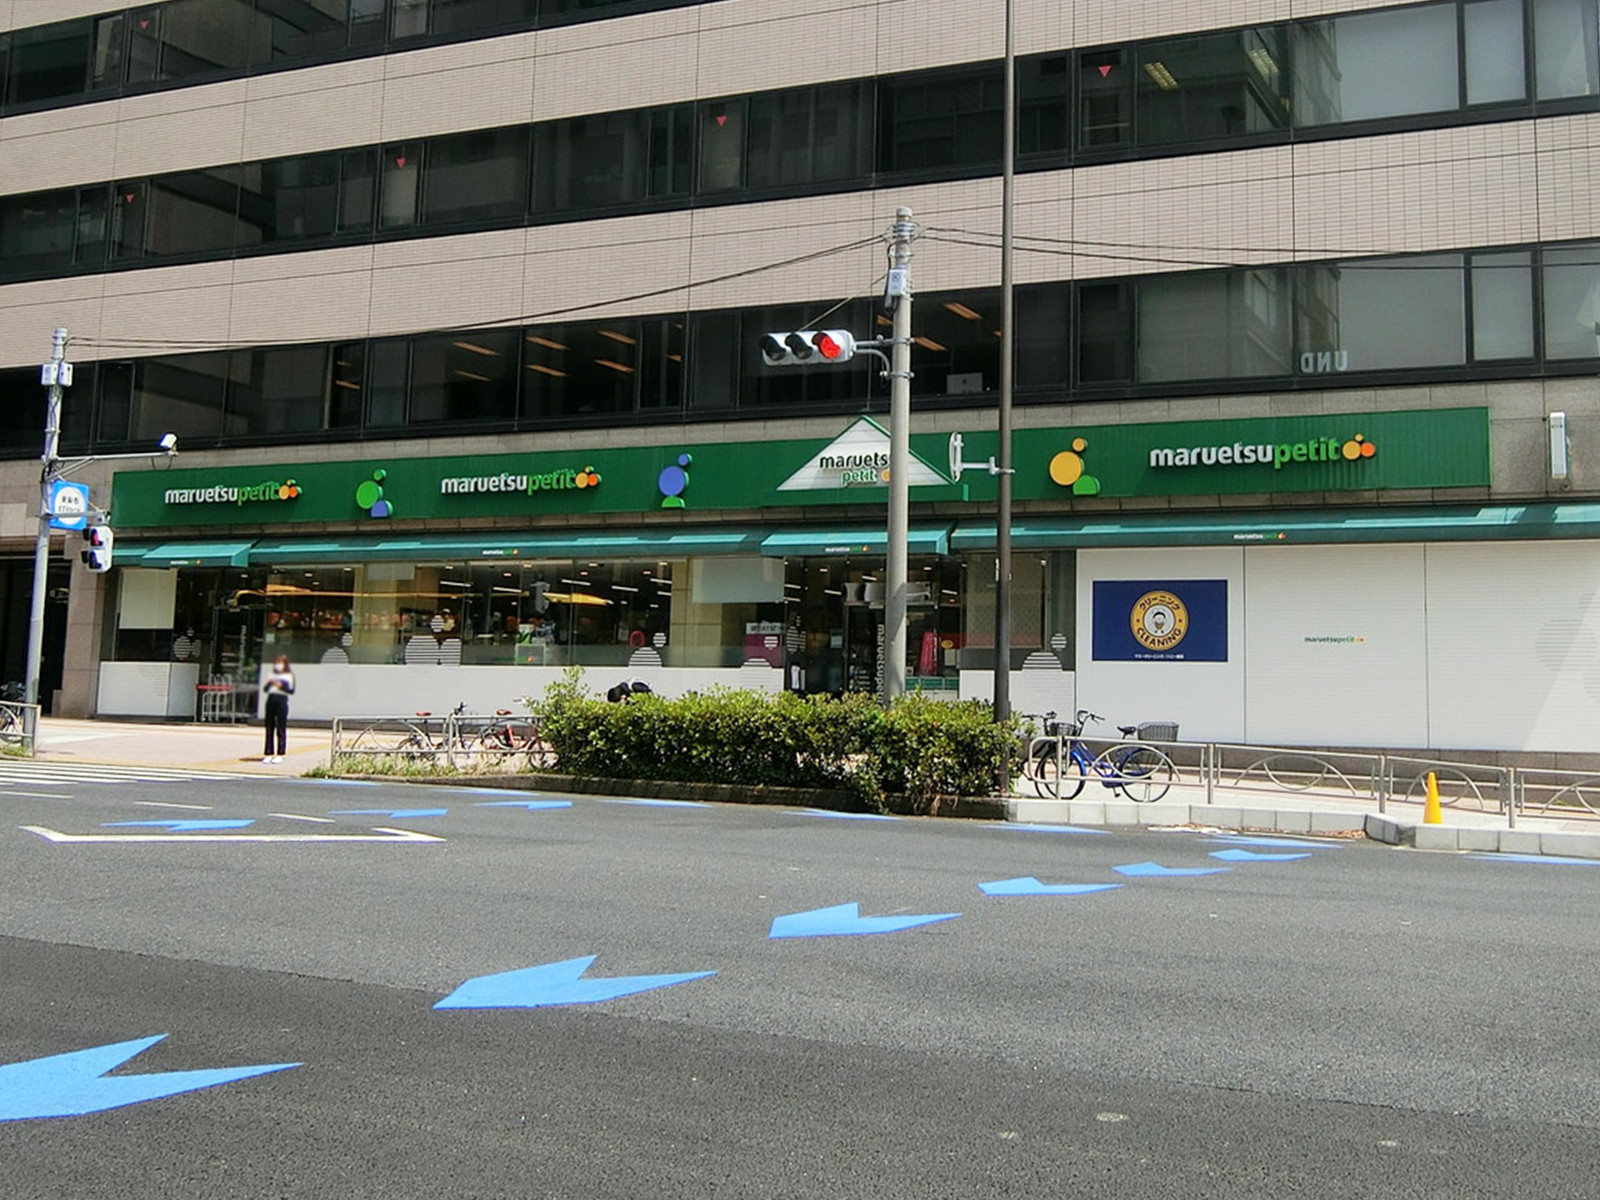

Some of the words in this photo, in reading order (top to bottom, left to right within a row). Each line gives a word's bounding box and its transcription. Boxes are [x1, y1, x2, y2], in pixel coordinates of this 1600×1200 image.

[819, 452, 889, 469] maruets
[842, 469, 877, 487] petit
[1139, 594, 1181, 611] クリーニング
[1136, 626, 1182, 647] CLEANING
